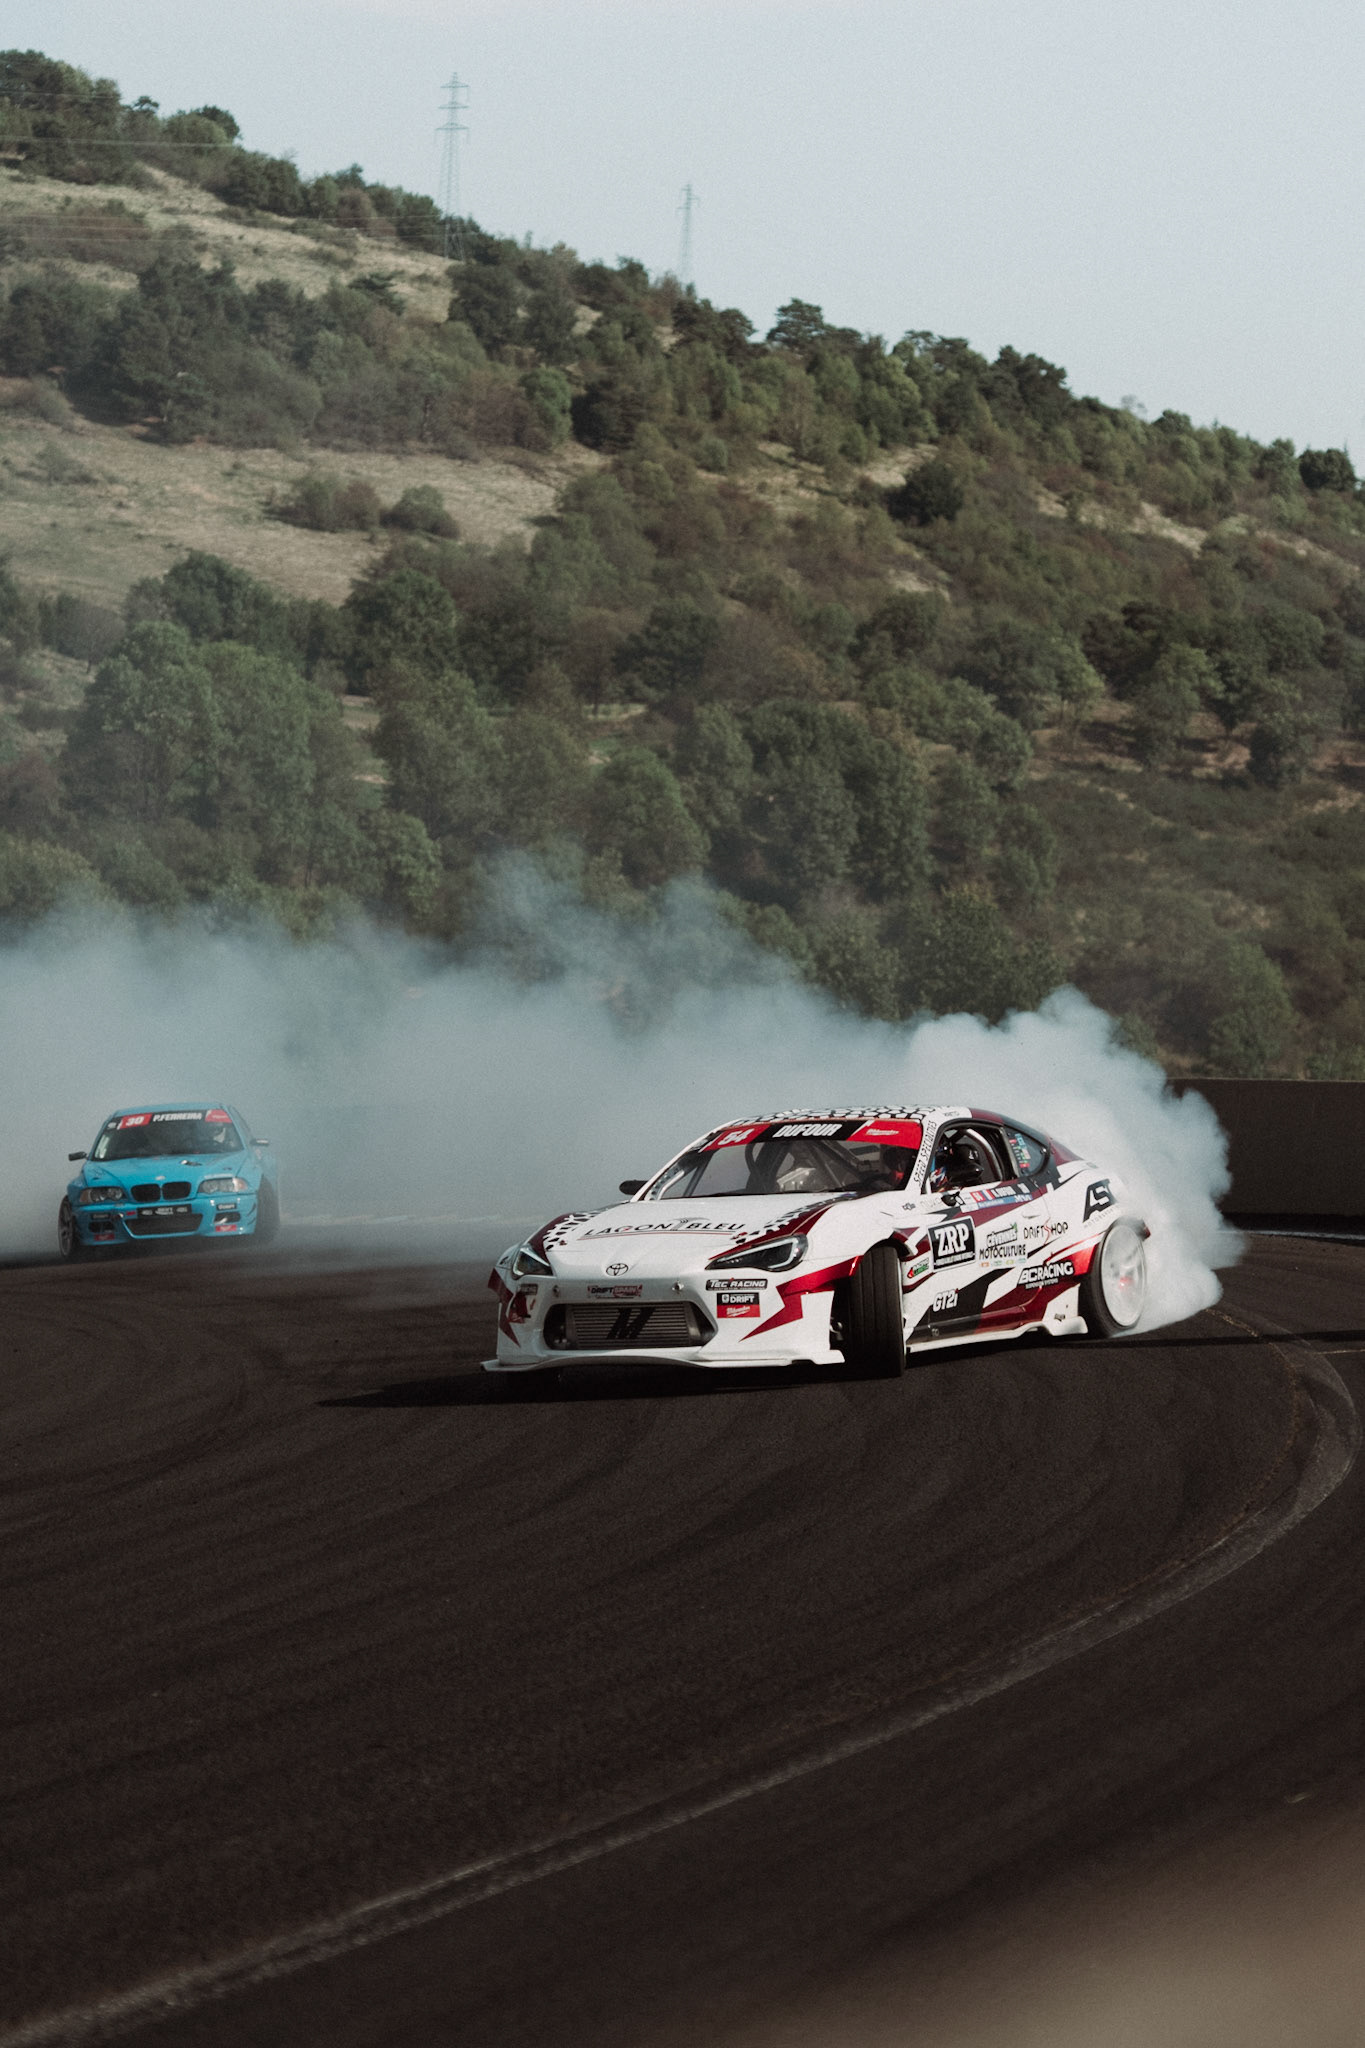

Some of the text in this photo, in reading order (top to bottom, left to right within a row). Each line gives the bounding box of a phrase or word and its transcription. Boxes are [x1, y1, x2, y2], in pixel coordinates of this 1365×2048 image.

[717, 1129, 754, 1146] 54
[772, 1123, 842, 1138] DUFOUR
[913, 1159, 927, 1187] SPEED
[584, 1222, 746, 1236] LAGON BLEU
[934, 1223, 969, 1257] ZRP
[979, 1244, 1026, 1260] MOTOCULTURE
[710, 1280, 766, 1288] TEC RACING
[730, 1295, 755, 1303] DRIFT
